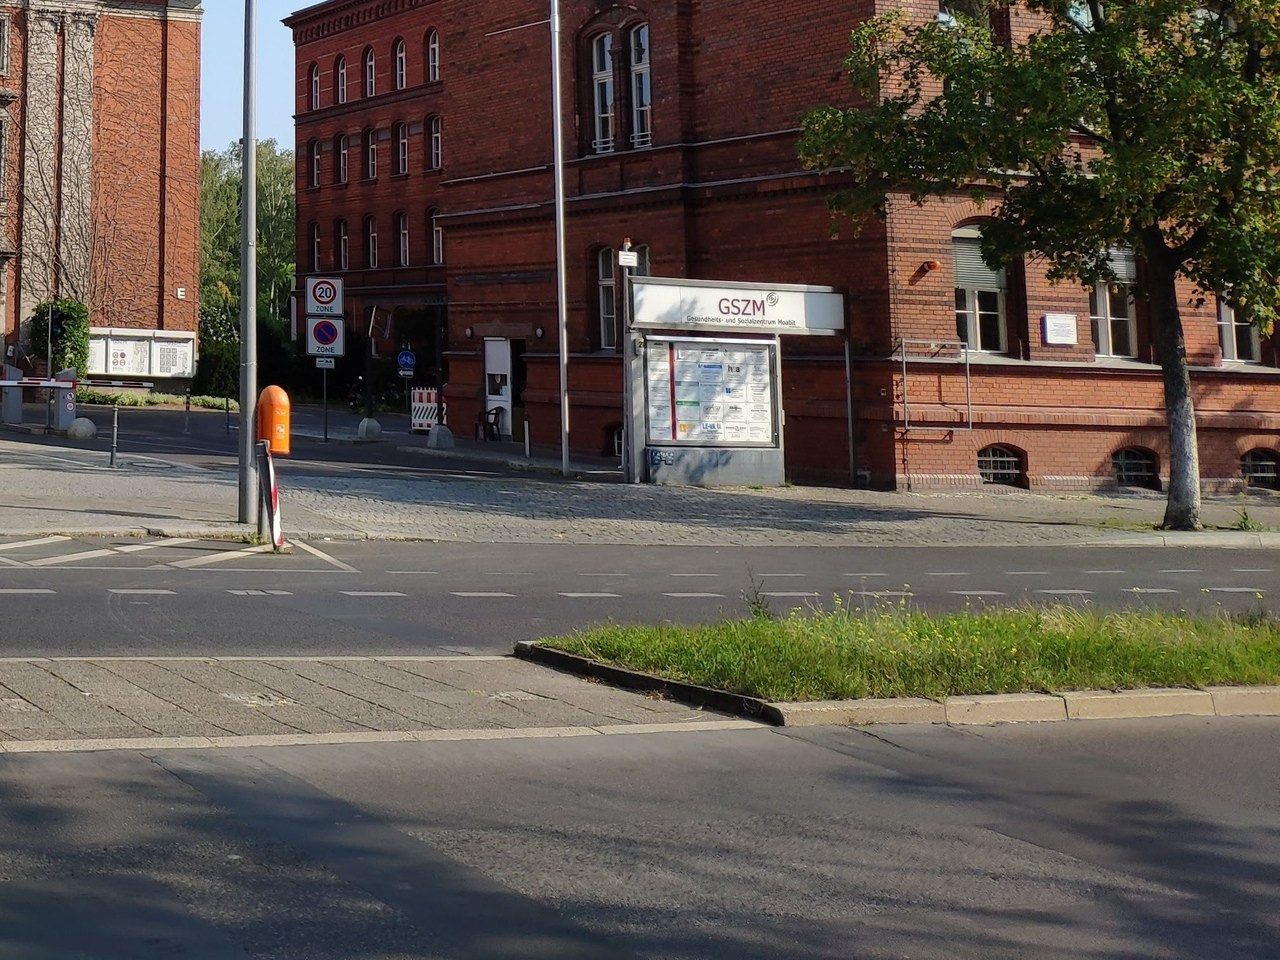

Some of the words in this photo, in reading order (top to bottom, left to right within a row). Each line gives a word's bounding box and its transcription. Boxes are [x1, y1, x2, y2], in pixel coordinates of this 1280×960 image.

[177, 288, 186, 299] E
[318, 287, 332, 298] 20
[718, 298, 765, 316] GSZM
[686, 315, 724, 323] Gesundheits-
[737, 317, 776, 325] Sozialzentrum
